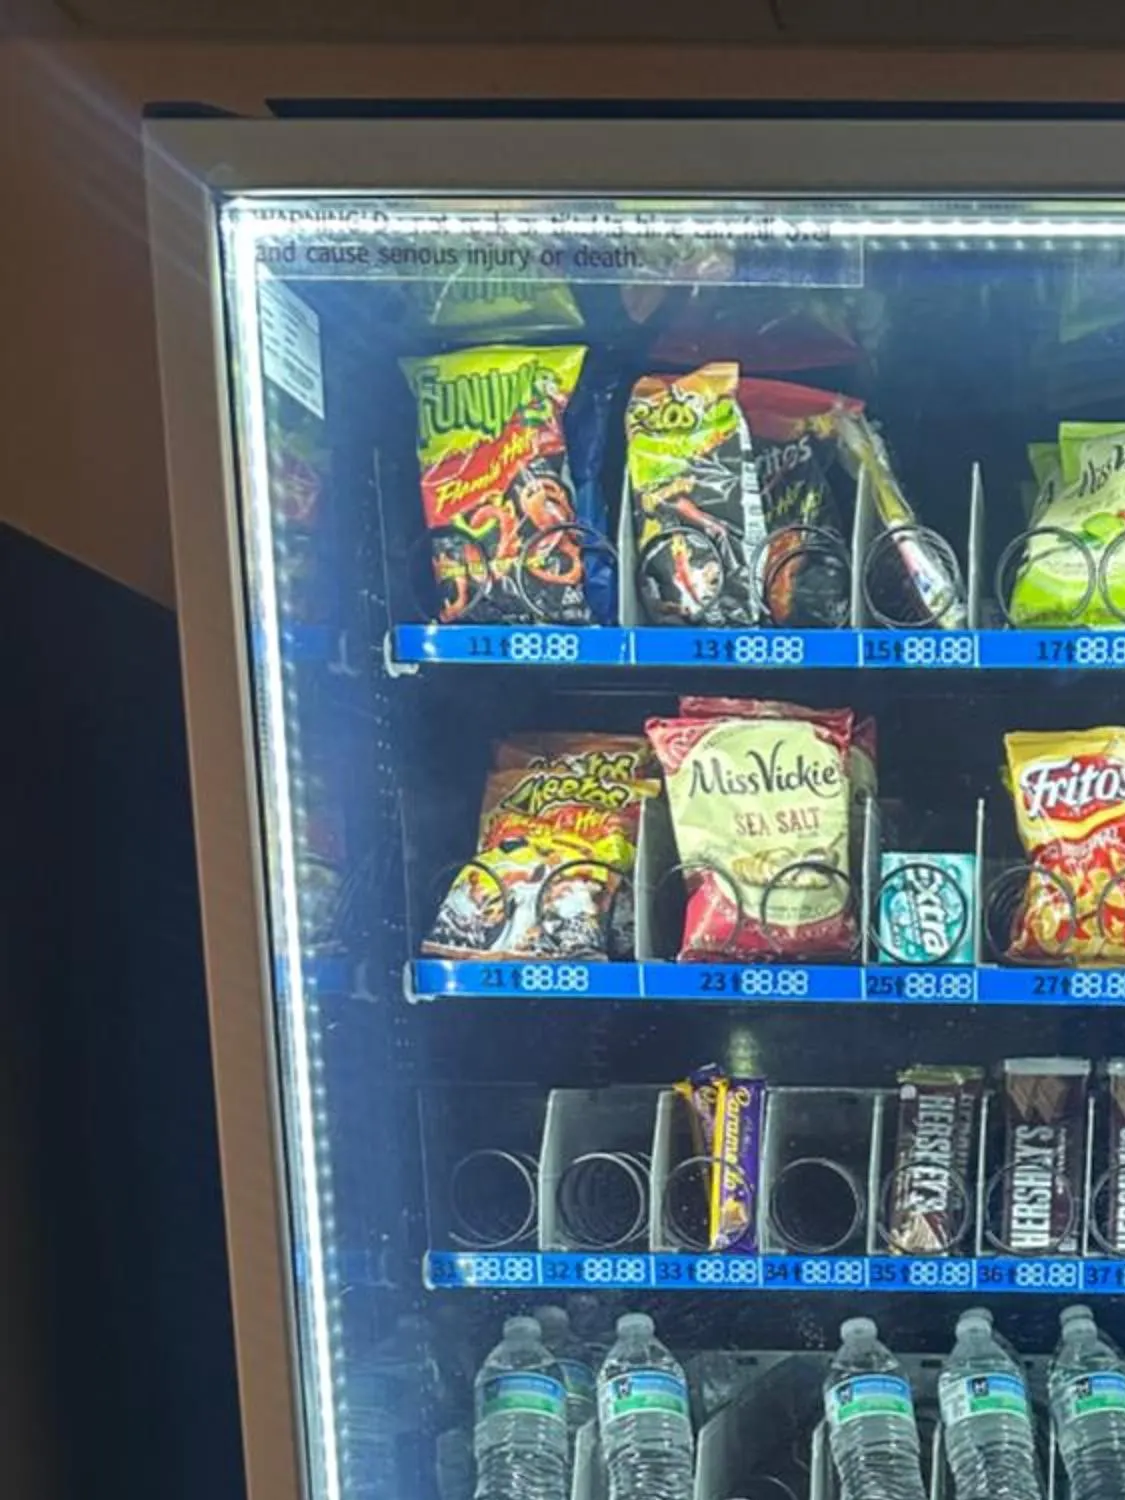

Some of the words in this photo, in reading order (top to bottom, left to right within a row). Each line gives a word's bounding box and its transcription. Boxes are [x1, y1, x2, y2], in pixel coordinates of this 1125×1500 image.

[306, 246, 369, 264] cause
[468, 244, 530, 271] injury
[540, 249, 567, 267] or
[573, 245, 644, 267] death.
[470, 637, 493, 656] 11
[511, 633, 579, 661] 88.88
[693, 639, 717, 658] 13
[735, 636, 804, 662] 88.88
[866, 640, 890, 659] 15
[903, 637, 973, 663] 88.88
[1037, 641, 1066, 661] 17
[688, 757, 760, 798] Miss
[748, 740, 841, 798] Vickie'
[733, 811, 771, 837] SEA
[775, 806, 821, 834] SALT
[521, 965, 589, 991] 88.88
[701, 973, 726, 991] 23
[741, 969, 808, 996] 88.88
[904, 973, 972, 999] 88.88
[1033, 976, 1059, 995] 27
